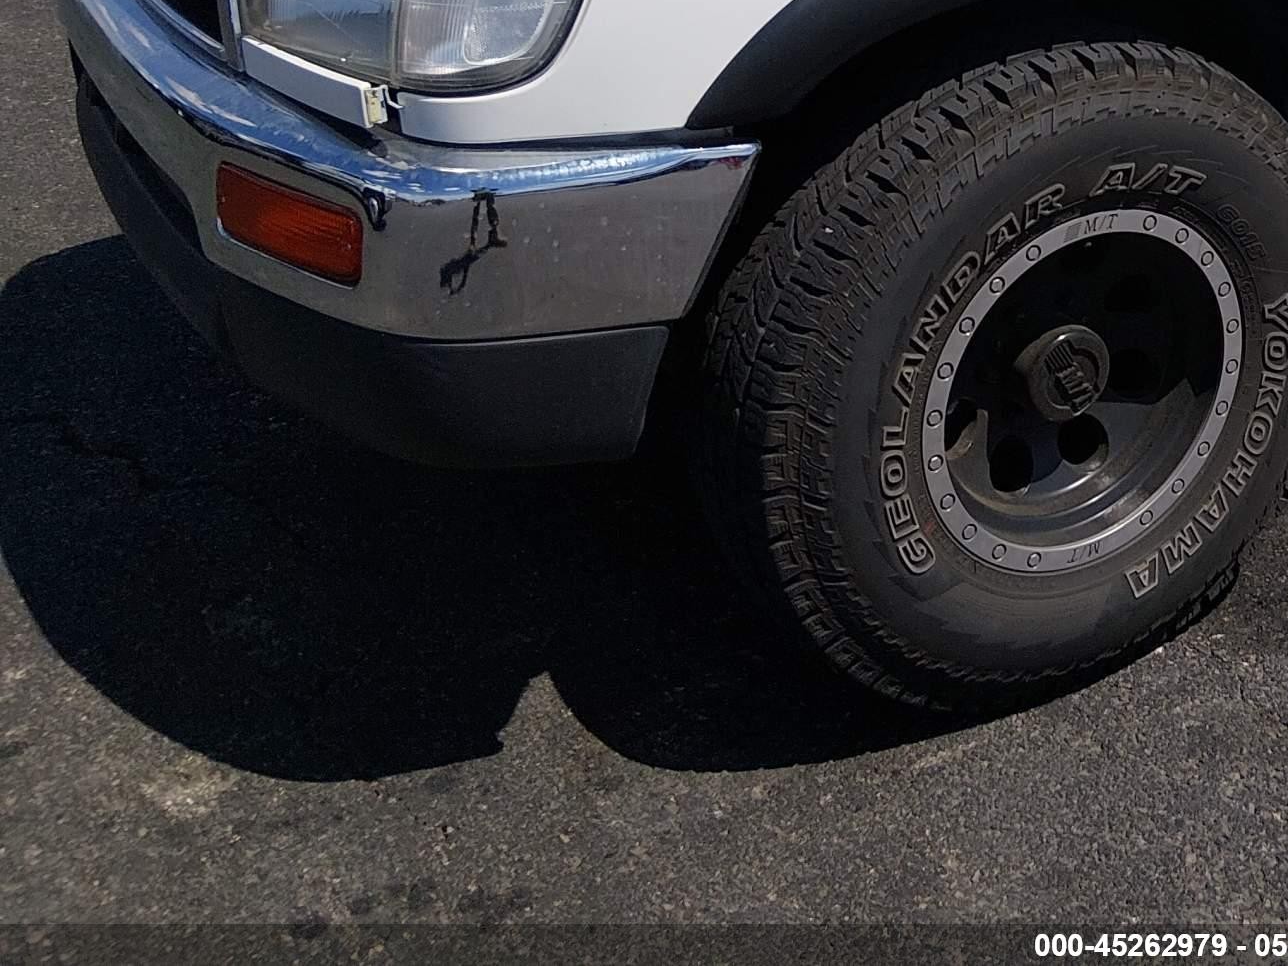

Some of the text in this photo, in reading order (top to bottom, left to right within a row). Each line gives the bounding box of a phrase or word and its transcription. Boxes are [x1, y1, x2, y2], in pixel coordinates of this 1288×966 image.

[1083, 213, 1119, 235] M/T
[880, 184, 1065, 575] GEOLANDAR
[1089, 162, 1207, 195] A/T
